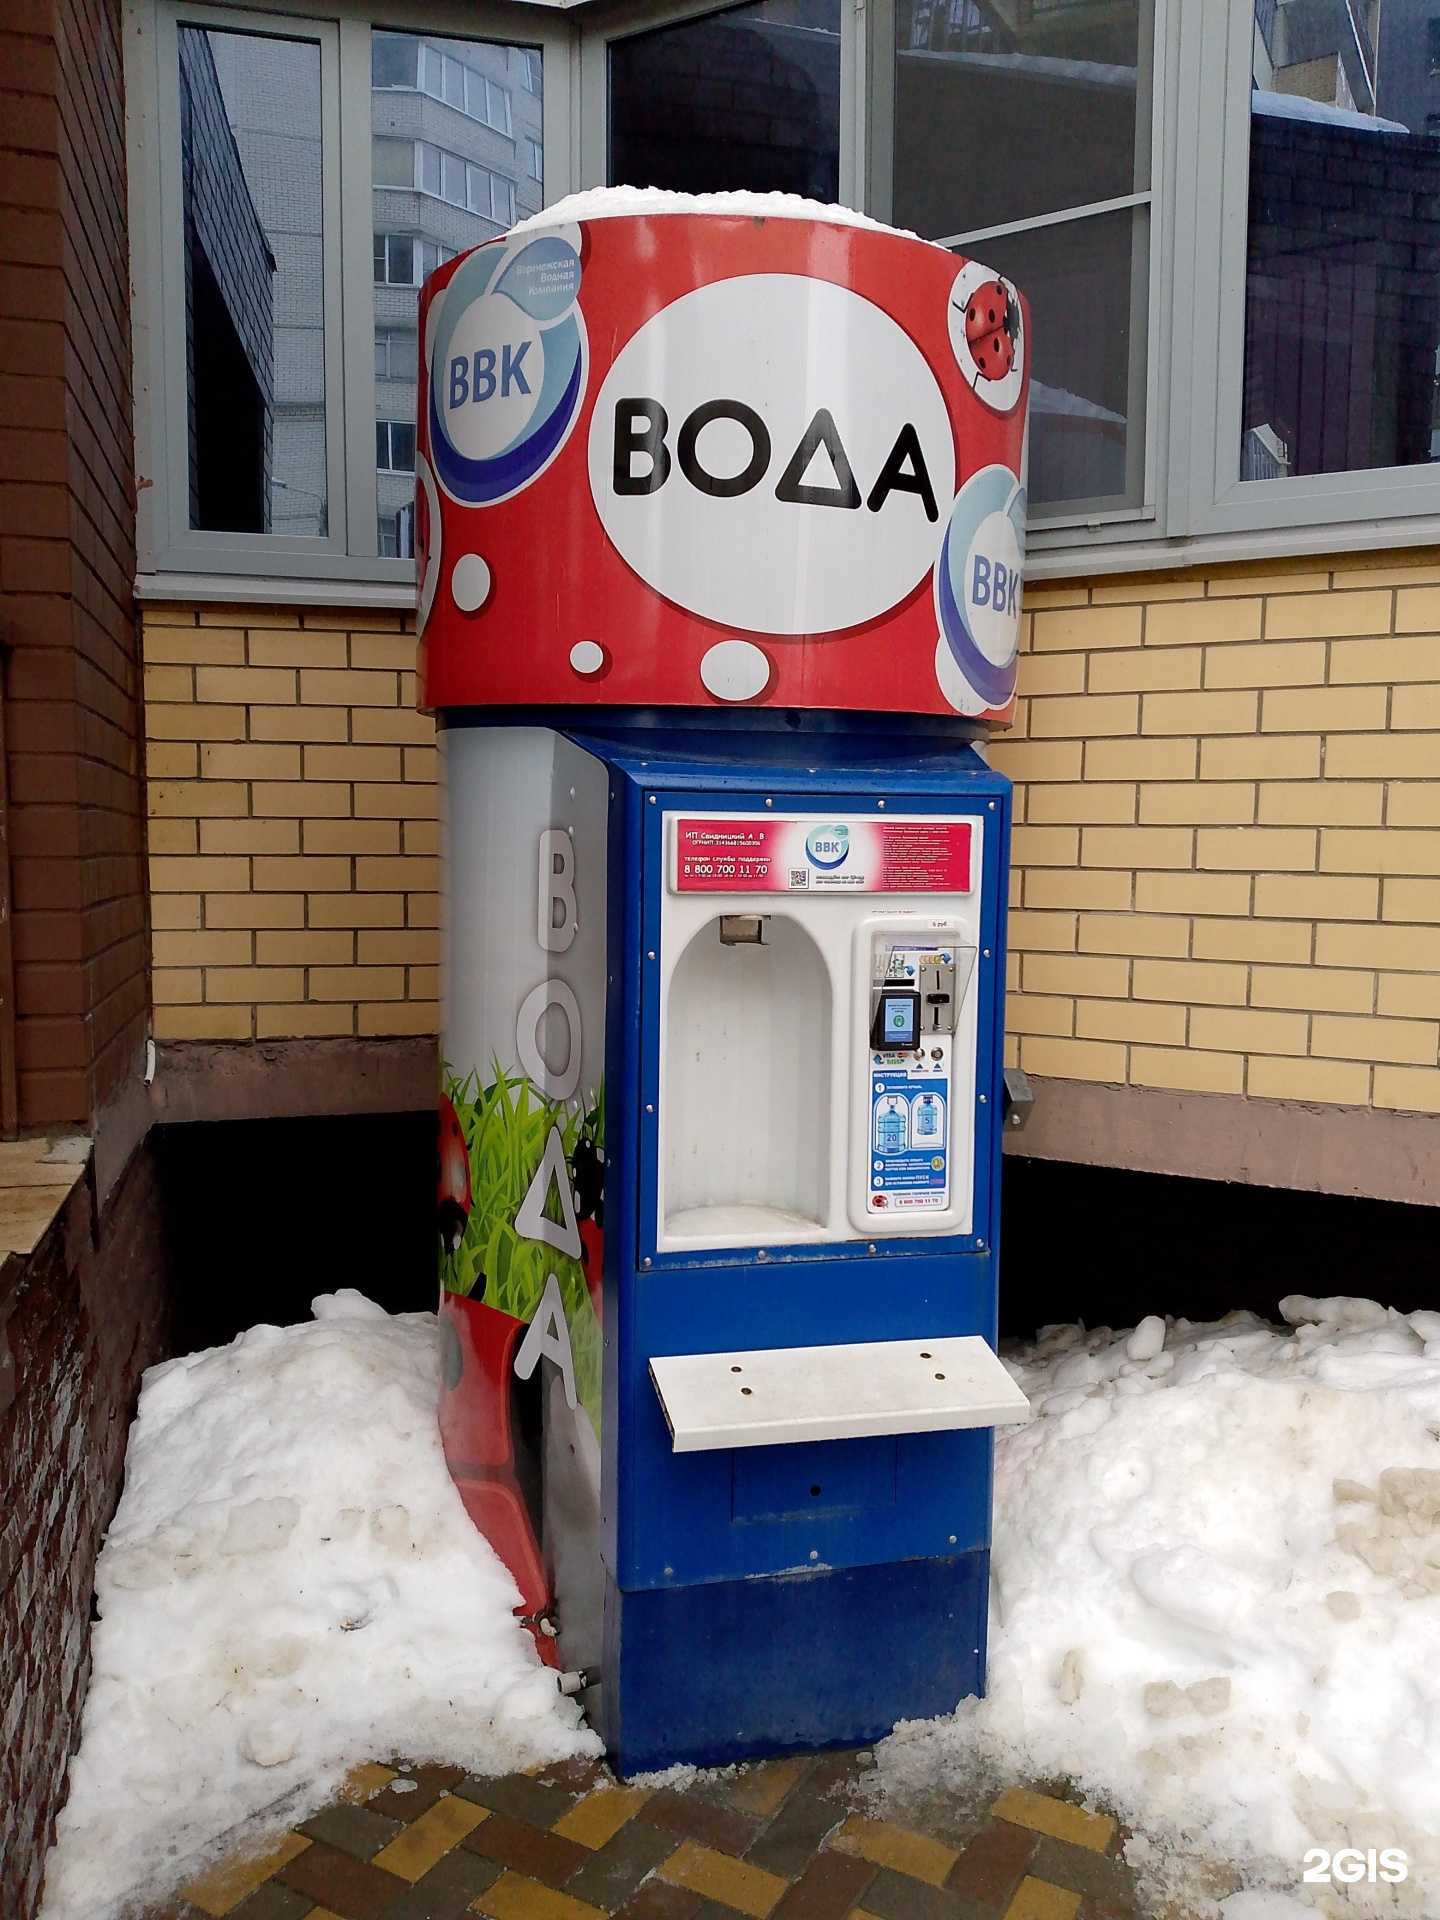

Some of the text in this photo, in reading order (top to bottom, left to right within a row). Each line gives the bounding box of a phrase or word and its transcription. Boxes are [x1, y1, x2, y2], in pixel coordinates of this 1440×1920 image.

[540, 271, 575, 282] Водная
[449, 341, 532, 410] ВВК
[613, 397, 939, 523] ВОДА
[972, 555, 1021, 620] ВВК
[684, 864, 768, 874] 8 800 700 11 70
[815, 842, 840, 853] ВВК
[514, 828, 582, 1411] ВОДА
